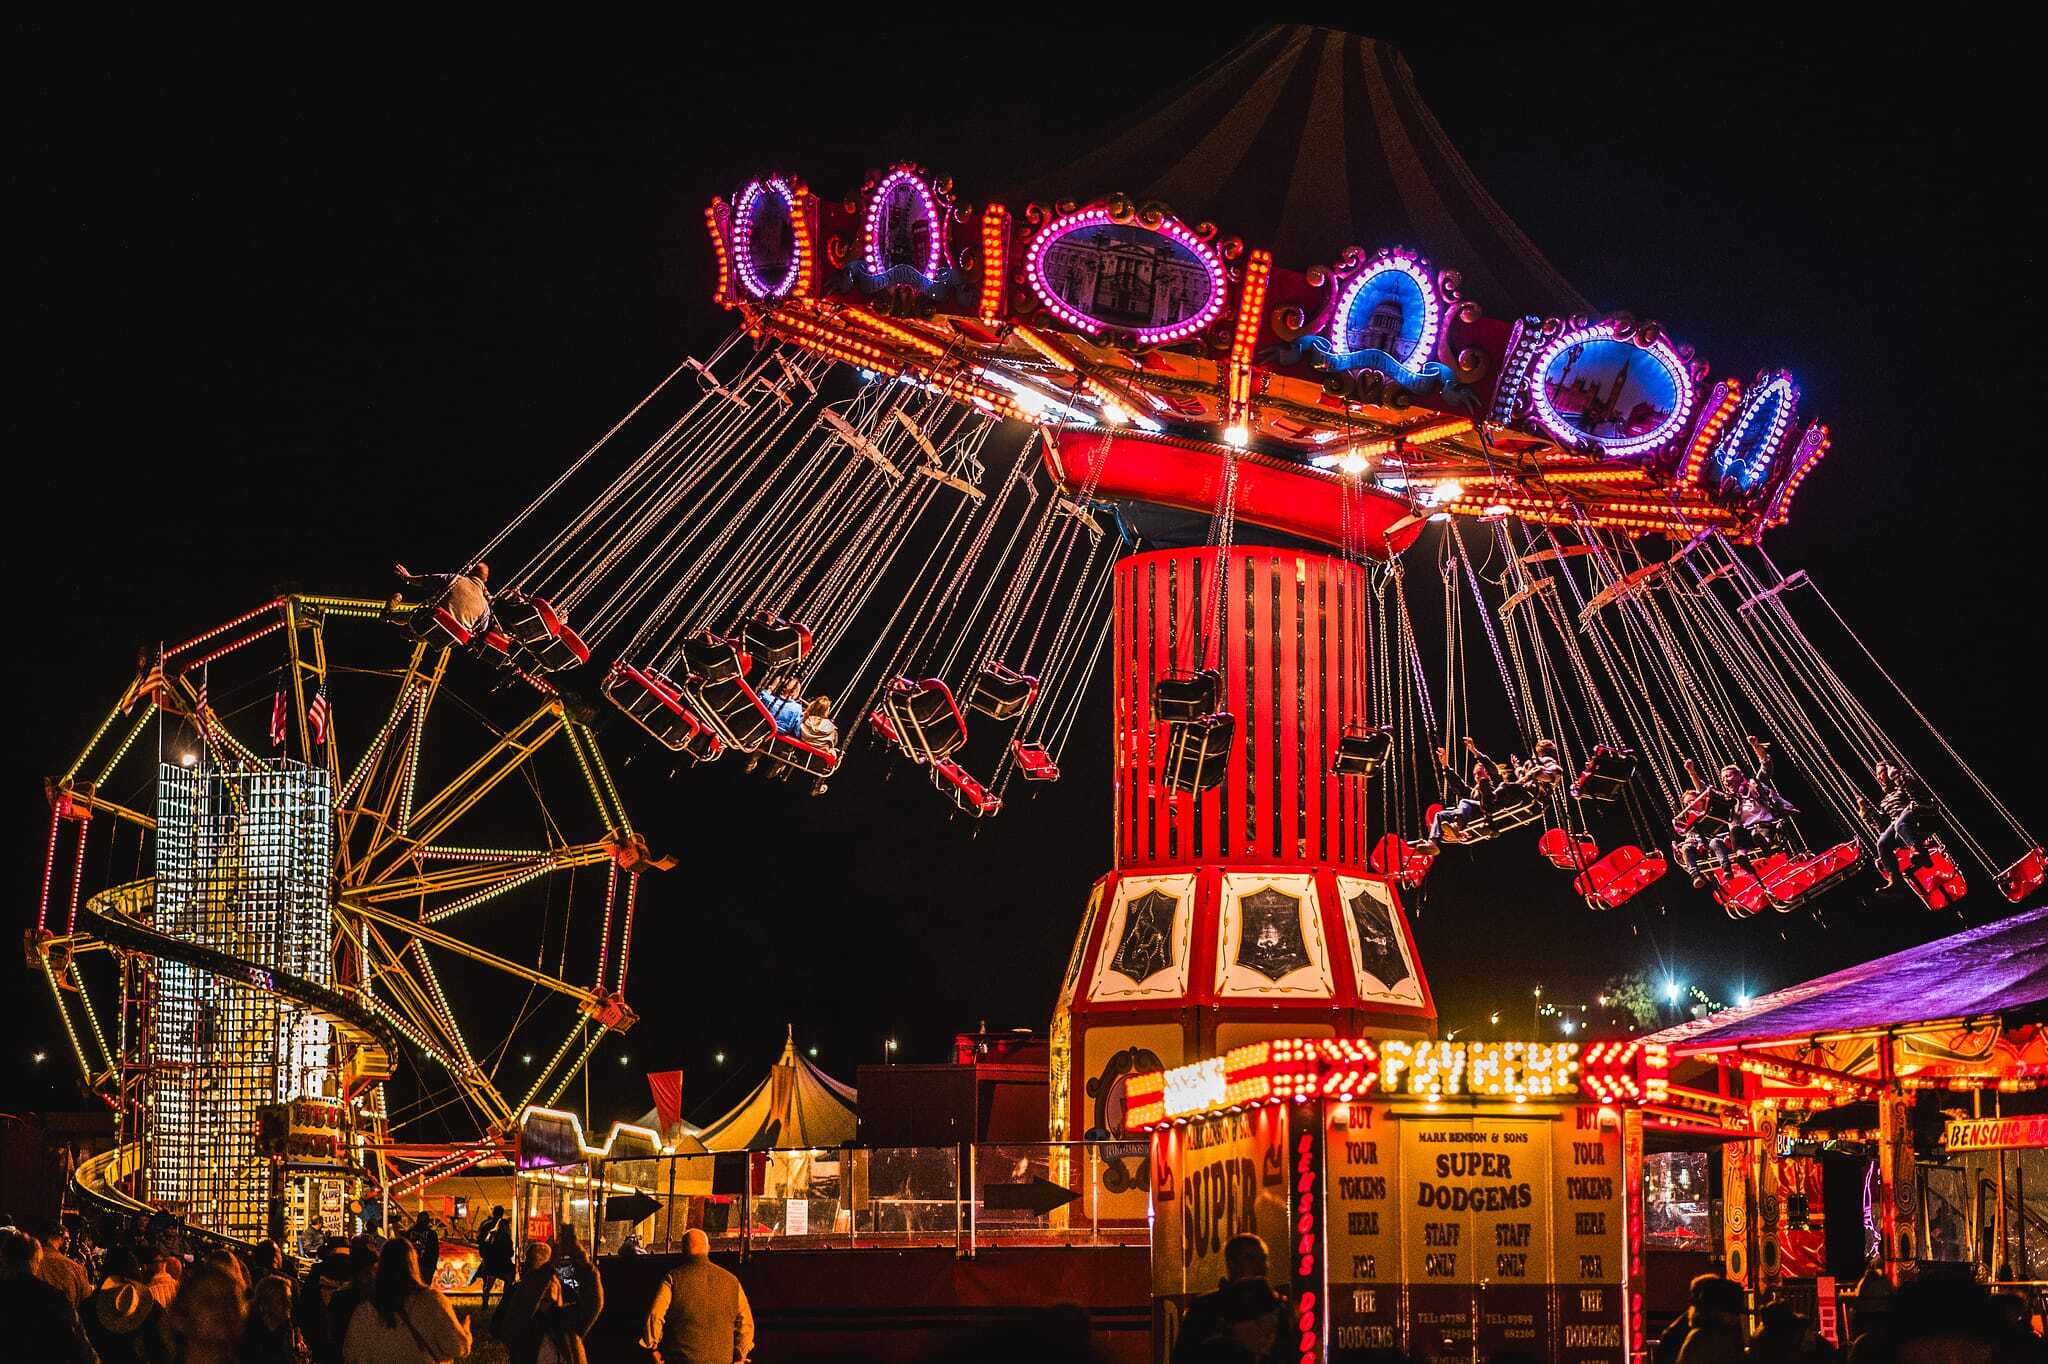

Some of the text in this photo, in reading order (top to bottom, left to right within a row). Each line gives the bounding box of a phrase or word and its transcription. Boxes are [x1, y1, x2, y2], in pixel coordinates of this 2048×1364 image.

[1380, 1041, 1578, 1093] PAY HERE
[1349, 1106, 1373, 1128] BUY
[1576, 1107, 1600, 1130] BUY
[1418, 1132, 1529, 1143] MARK BENSON & SONS
[1950, 1121, 2020, 1147] BENSONS
[1345, 1142, 1378, 1165] YOUR
[1436, 1152, 1512, 1179] SUPER
[1572, 1142, 1605, 1166] YOUR
[1338, 1176, 1386, 1200] TOKENS
[1417, 1182, 1532, 1212] DODGEMS
[1566, 1176, 1613, 1200] TOKENS
[1182, 1157, 1257, 1268] SUPER
[1348, 1211, 1379, 1235] HERE
[1575, 1211, 1606, 1235] HERE
[528, 1221, 549, 1237] EXIT
[1424, 1223, 1460, 1247] STAFF
[1496, 1223, 1531, 1247] STAFF
[1353, 1255, 1377, 1278] FOR
[1425, 1254, 1456, 1277] ONLY
[1497, 1254, 1527, 1277] ONLY
[1580, 1254, 1603, 1278] FOR
[1352, 1290, 1376, 1313] THE
[1580, 1290, 1603, 1312] THE
[1337, 1326, 1393, 1349] DODGEMS
[1565, 1325, 1620, 1349] DODGEMS
